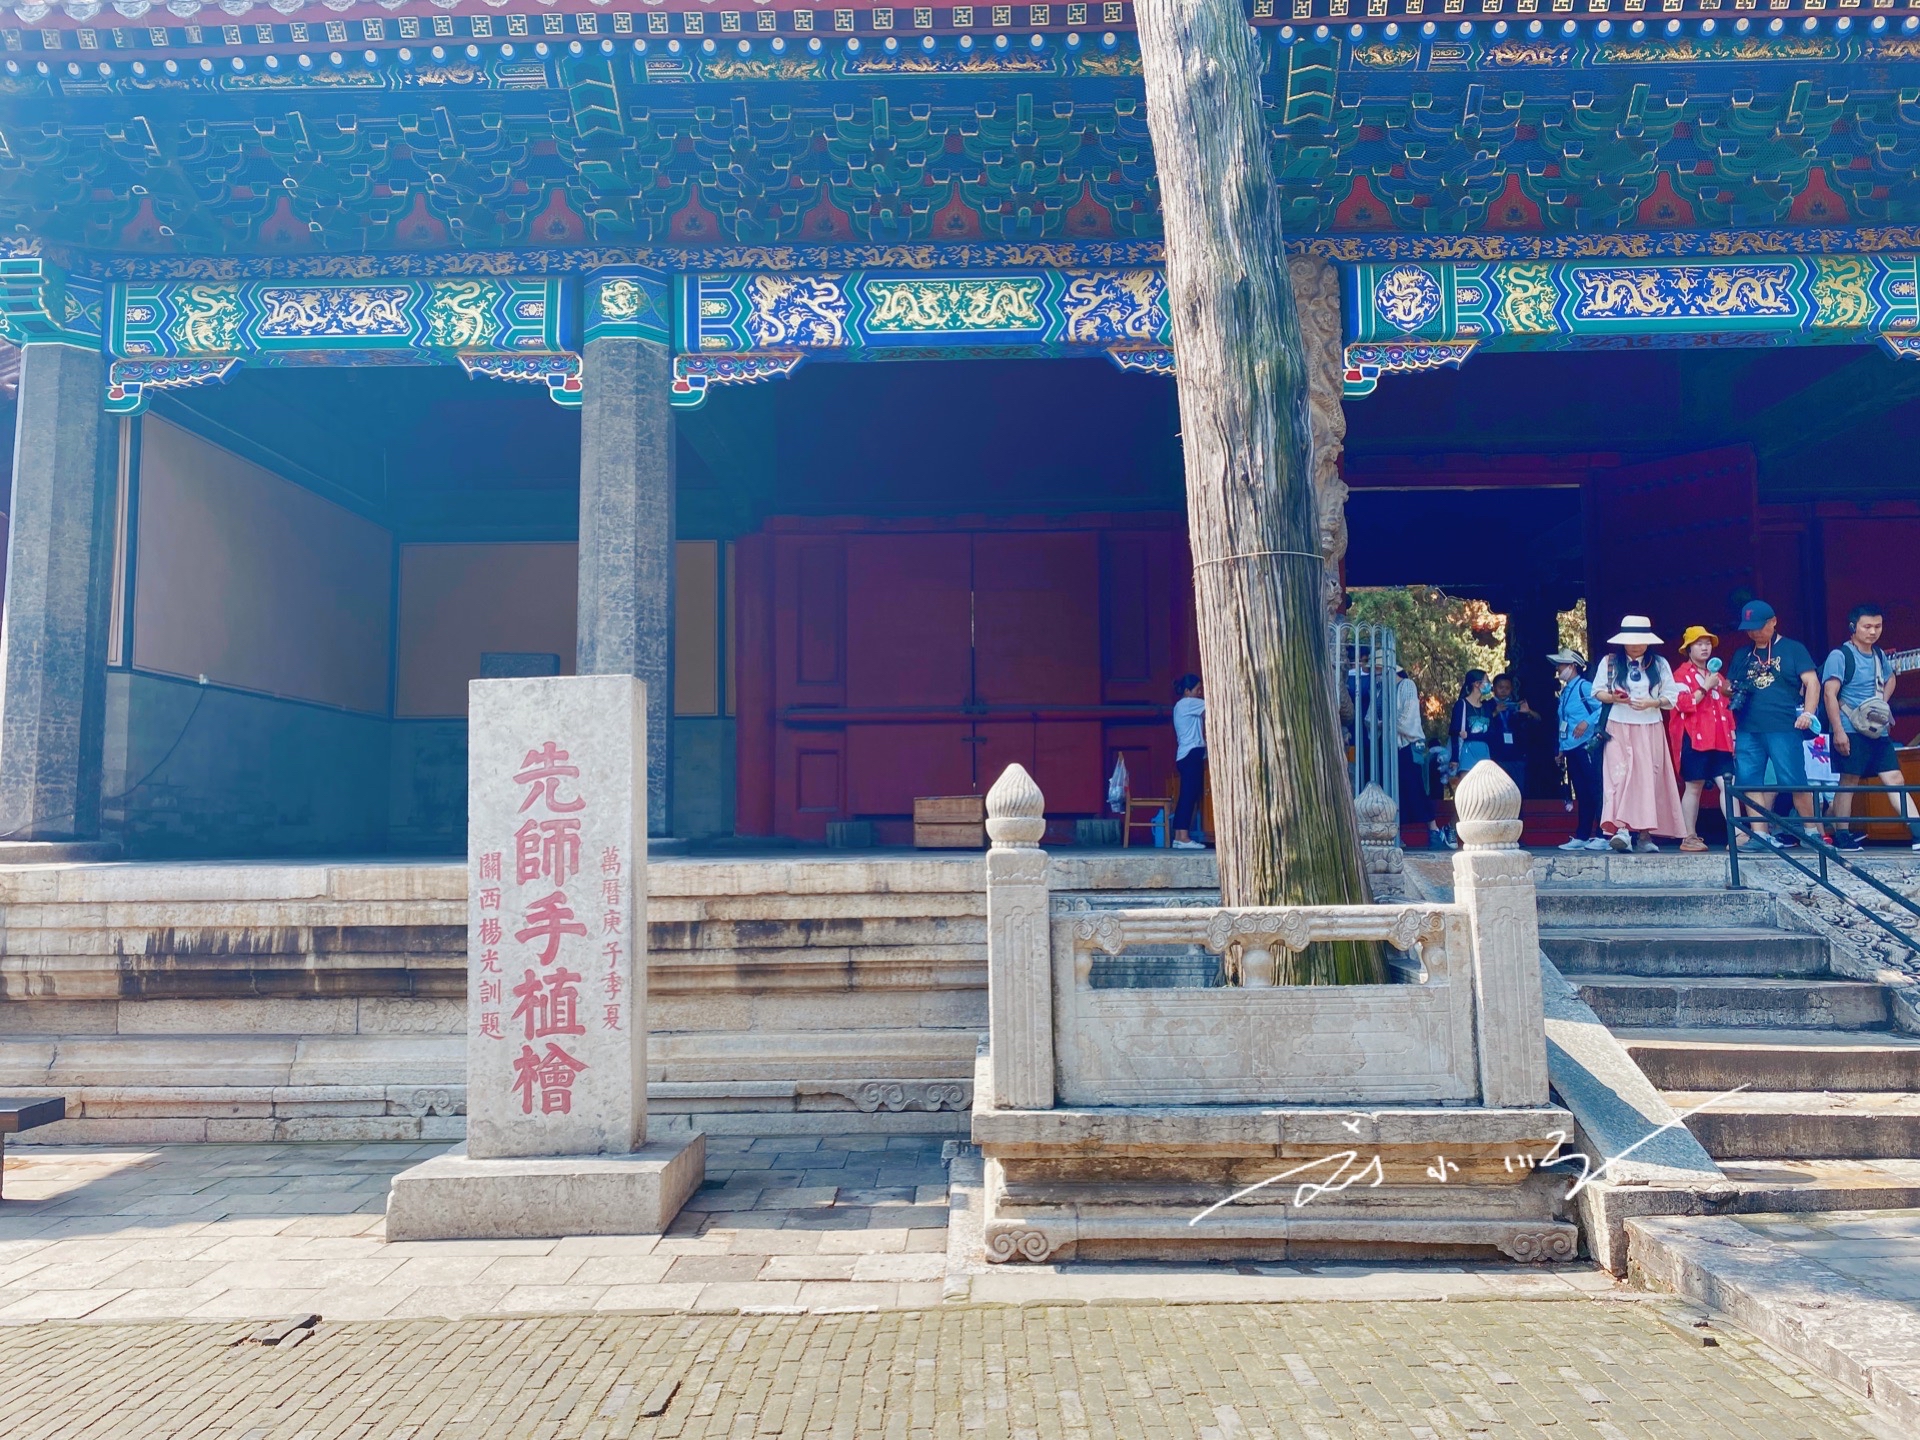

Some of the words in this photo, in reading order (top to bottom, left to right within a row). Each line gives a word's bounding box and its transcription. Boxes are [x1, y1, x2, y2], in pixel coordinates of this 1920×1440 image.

[512, 741, 589, 1116] 先師手植檜
